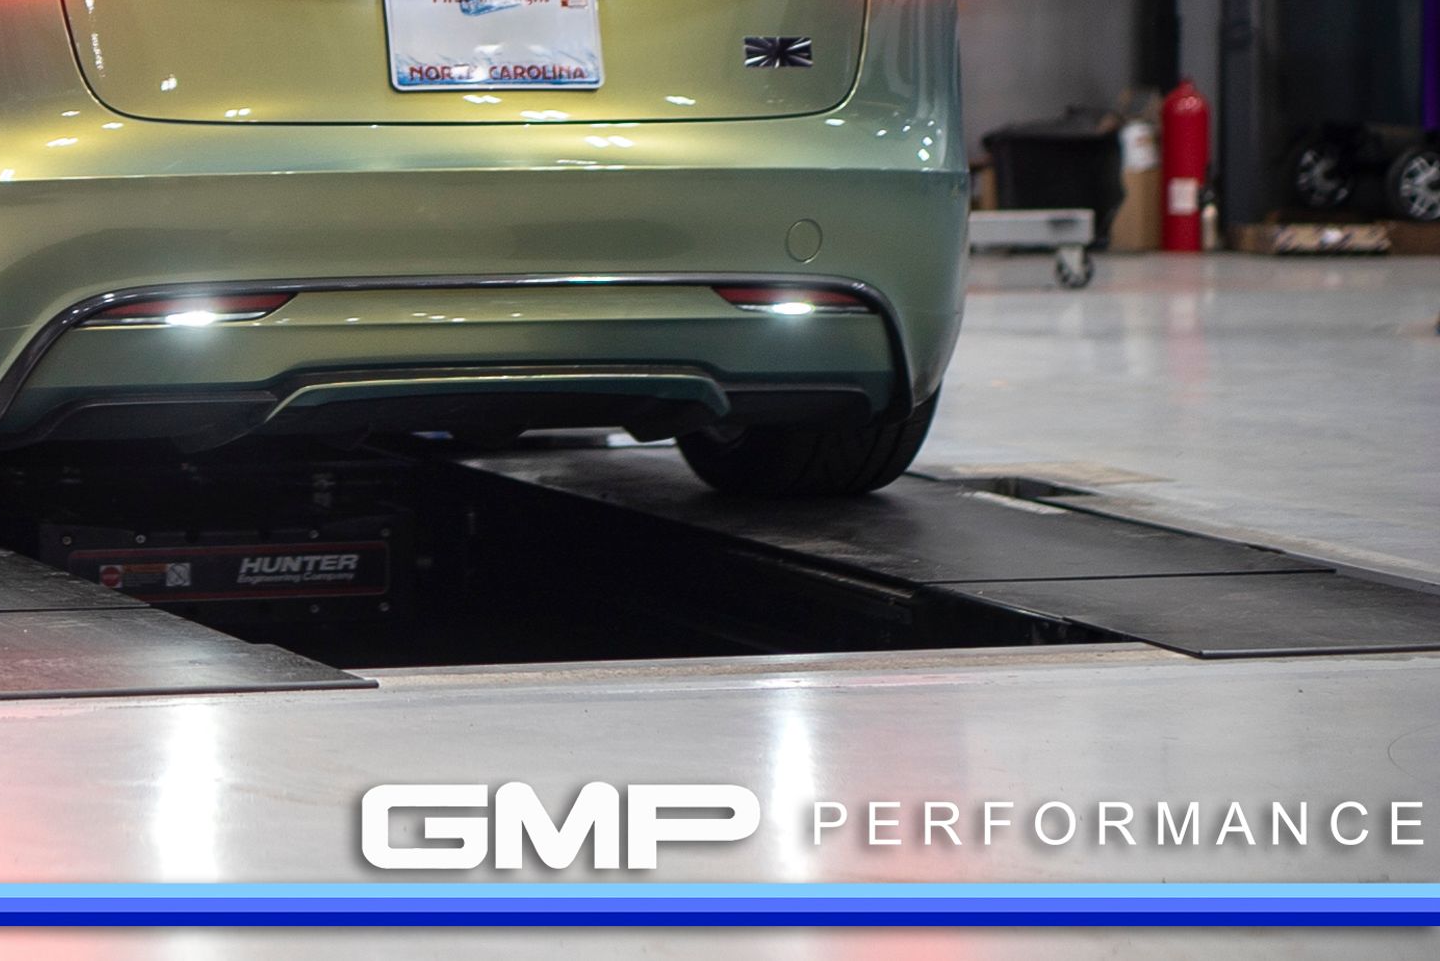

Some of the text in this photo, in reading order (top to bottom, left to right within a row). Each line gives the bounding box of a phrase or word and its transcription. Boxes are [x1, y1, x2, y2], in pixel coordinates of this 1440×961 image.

[409, 64, 586, 81] NOR CAROLINA
[239, 554, 359, 574] HUNTER
[237, 571, 355, 585] Engineering Company
